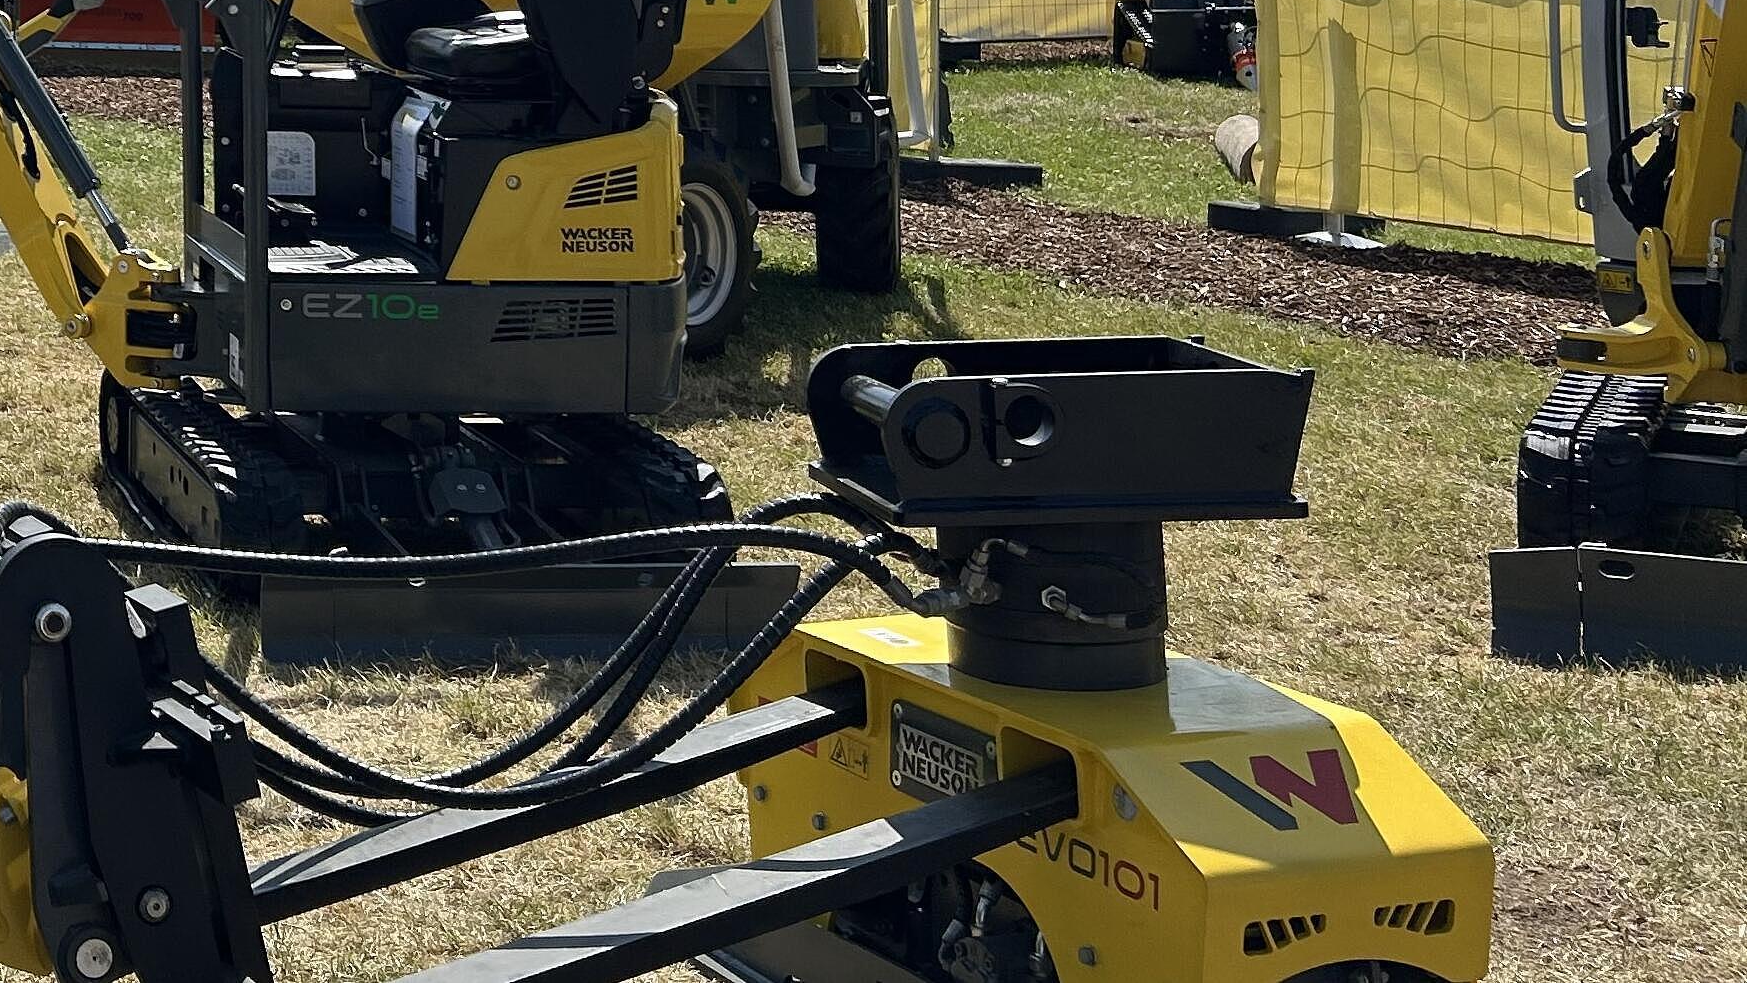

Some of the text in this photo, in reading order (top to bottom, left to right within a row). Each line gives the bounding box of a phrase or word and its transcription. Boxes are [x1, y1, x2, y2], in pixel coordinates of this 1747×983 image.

[561, 227, 633, 241] WACKER
[562, 241, 635, 254] NEUSON
[302, 293, 440, 319] EZ10e
[902, 728, 978, 777] WACKER
